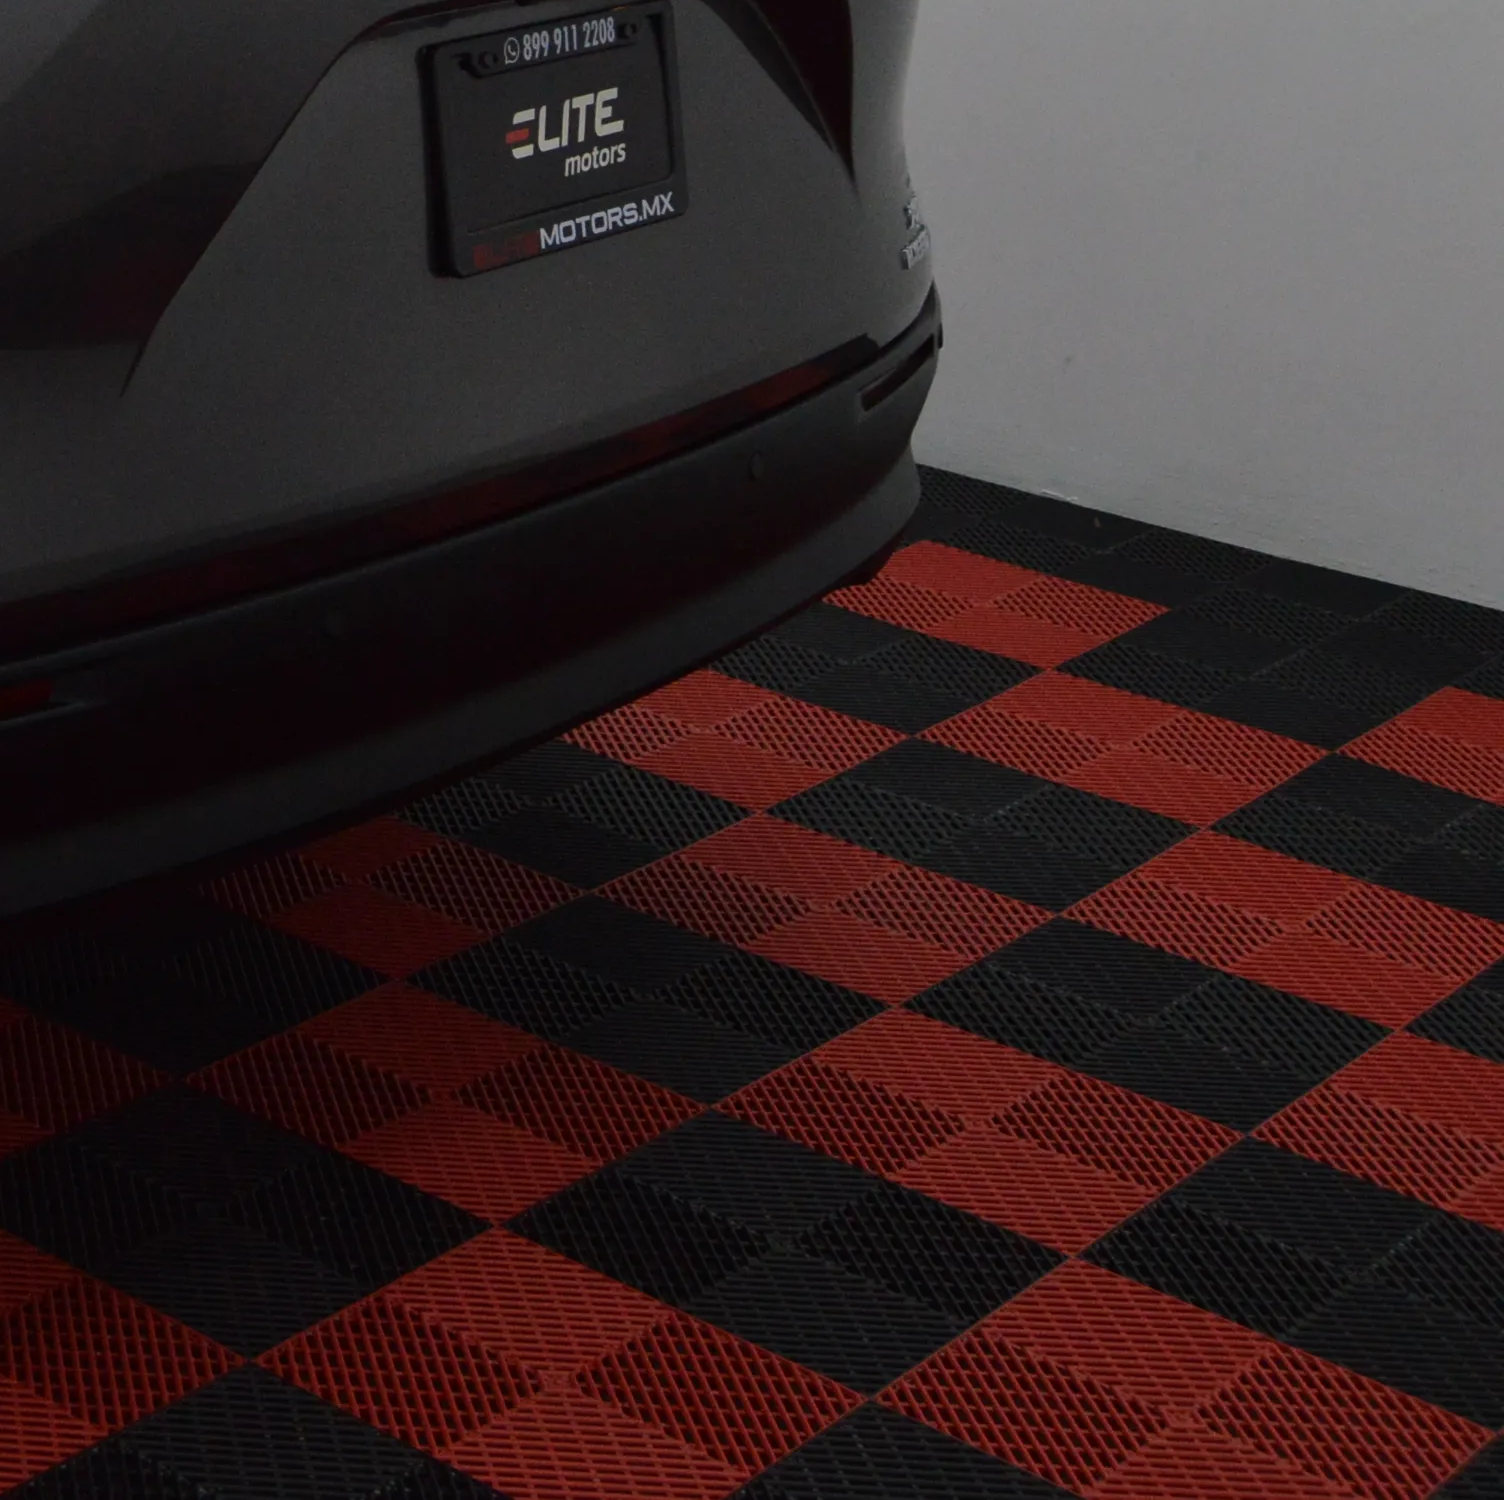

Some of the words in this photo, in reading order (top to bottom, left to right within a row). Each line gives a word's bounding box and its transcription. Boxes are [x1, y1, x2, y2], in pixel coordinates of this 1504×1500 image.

[522, 33, 550, 61] 899
[553, 27, 578, 55] 911
[582, 16, 616, 49] 2208
[505, 87, 625, 159] ELITE
[564, 143, 627, 178] motors
